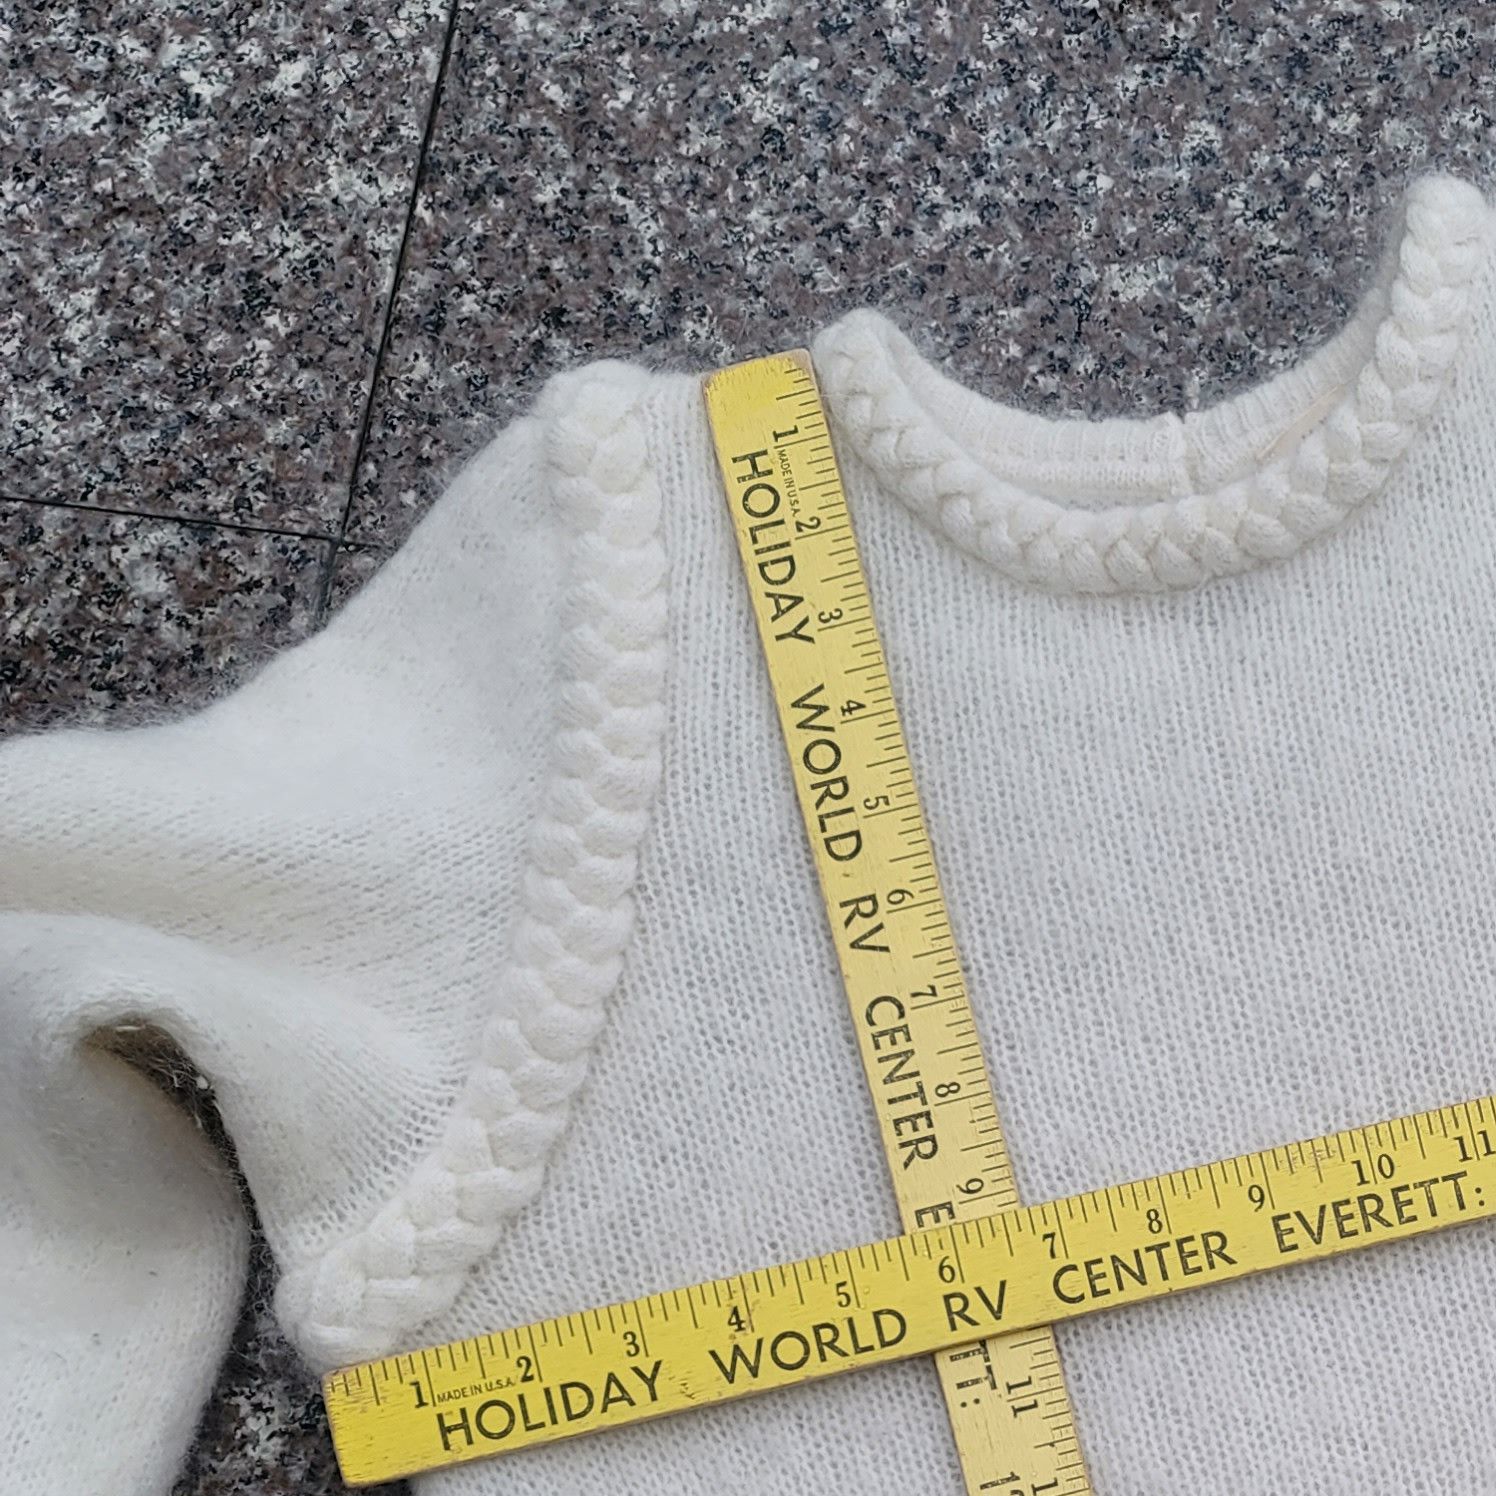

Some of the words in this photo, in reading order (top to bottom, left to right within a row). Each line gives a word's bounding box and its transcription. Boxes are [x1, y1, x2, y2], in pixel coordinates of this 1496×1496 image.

[730, 448, 816, 645] HOLIDAY
[789, 682, 864, 863] WORLD
[771, 424, 800, 444] 1
[794, 515, 823, 534] 2
[816, 606, 845, 625] 3
[839, 698, 867, 718] 4
[862, 794, 891, 812] 5
[885, 887, 915, 907] 6
[909, 983, 939, 999] 7
[933, 1080, 962, 1099] 8
[955, 1176, 986, 1196] 9
[1004, 1375, 1040, 1419] 11
[838, 892, 892, 954] RV
[864, 994, 940, 1171] CENTER
[408, 1379, 430, 1410] 1
[515, 1354, 536, 1384] 2
[621, 1329, 641, 1359] 3
[726, 1304, 747, 1334] 4
[834, 1279, 853, 1309] 5
[937, 1254, 957, 1285] 6
[1041, 1230, 1057, 1261] 7
[1145, 1207, 1164, 1236] 8
[1246, 1183, 1266, 1213] 9
[1350, 1152, 1396, 1187] 10
[435, 1358, 663, 1452] HOLIDAY
[707, 1307, 908, 1386] WORLD
[941, 1278, 1008, 1333] RV
[1051, 1229, 1239, 1306] CENTER
[1270, 1169, 1486, 1255] EVERETT:
